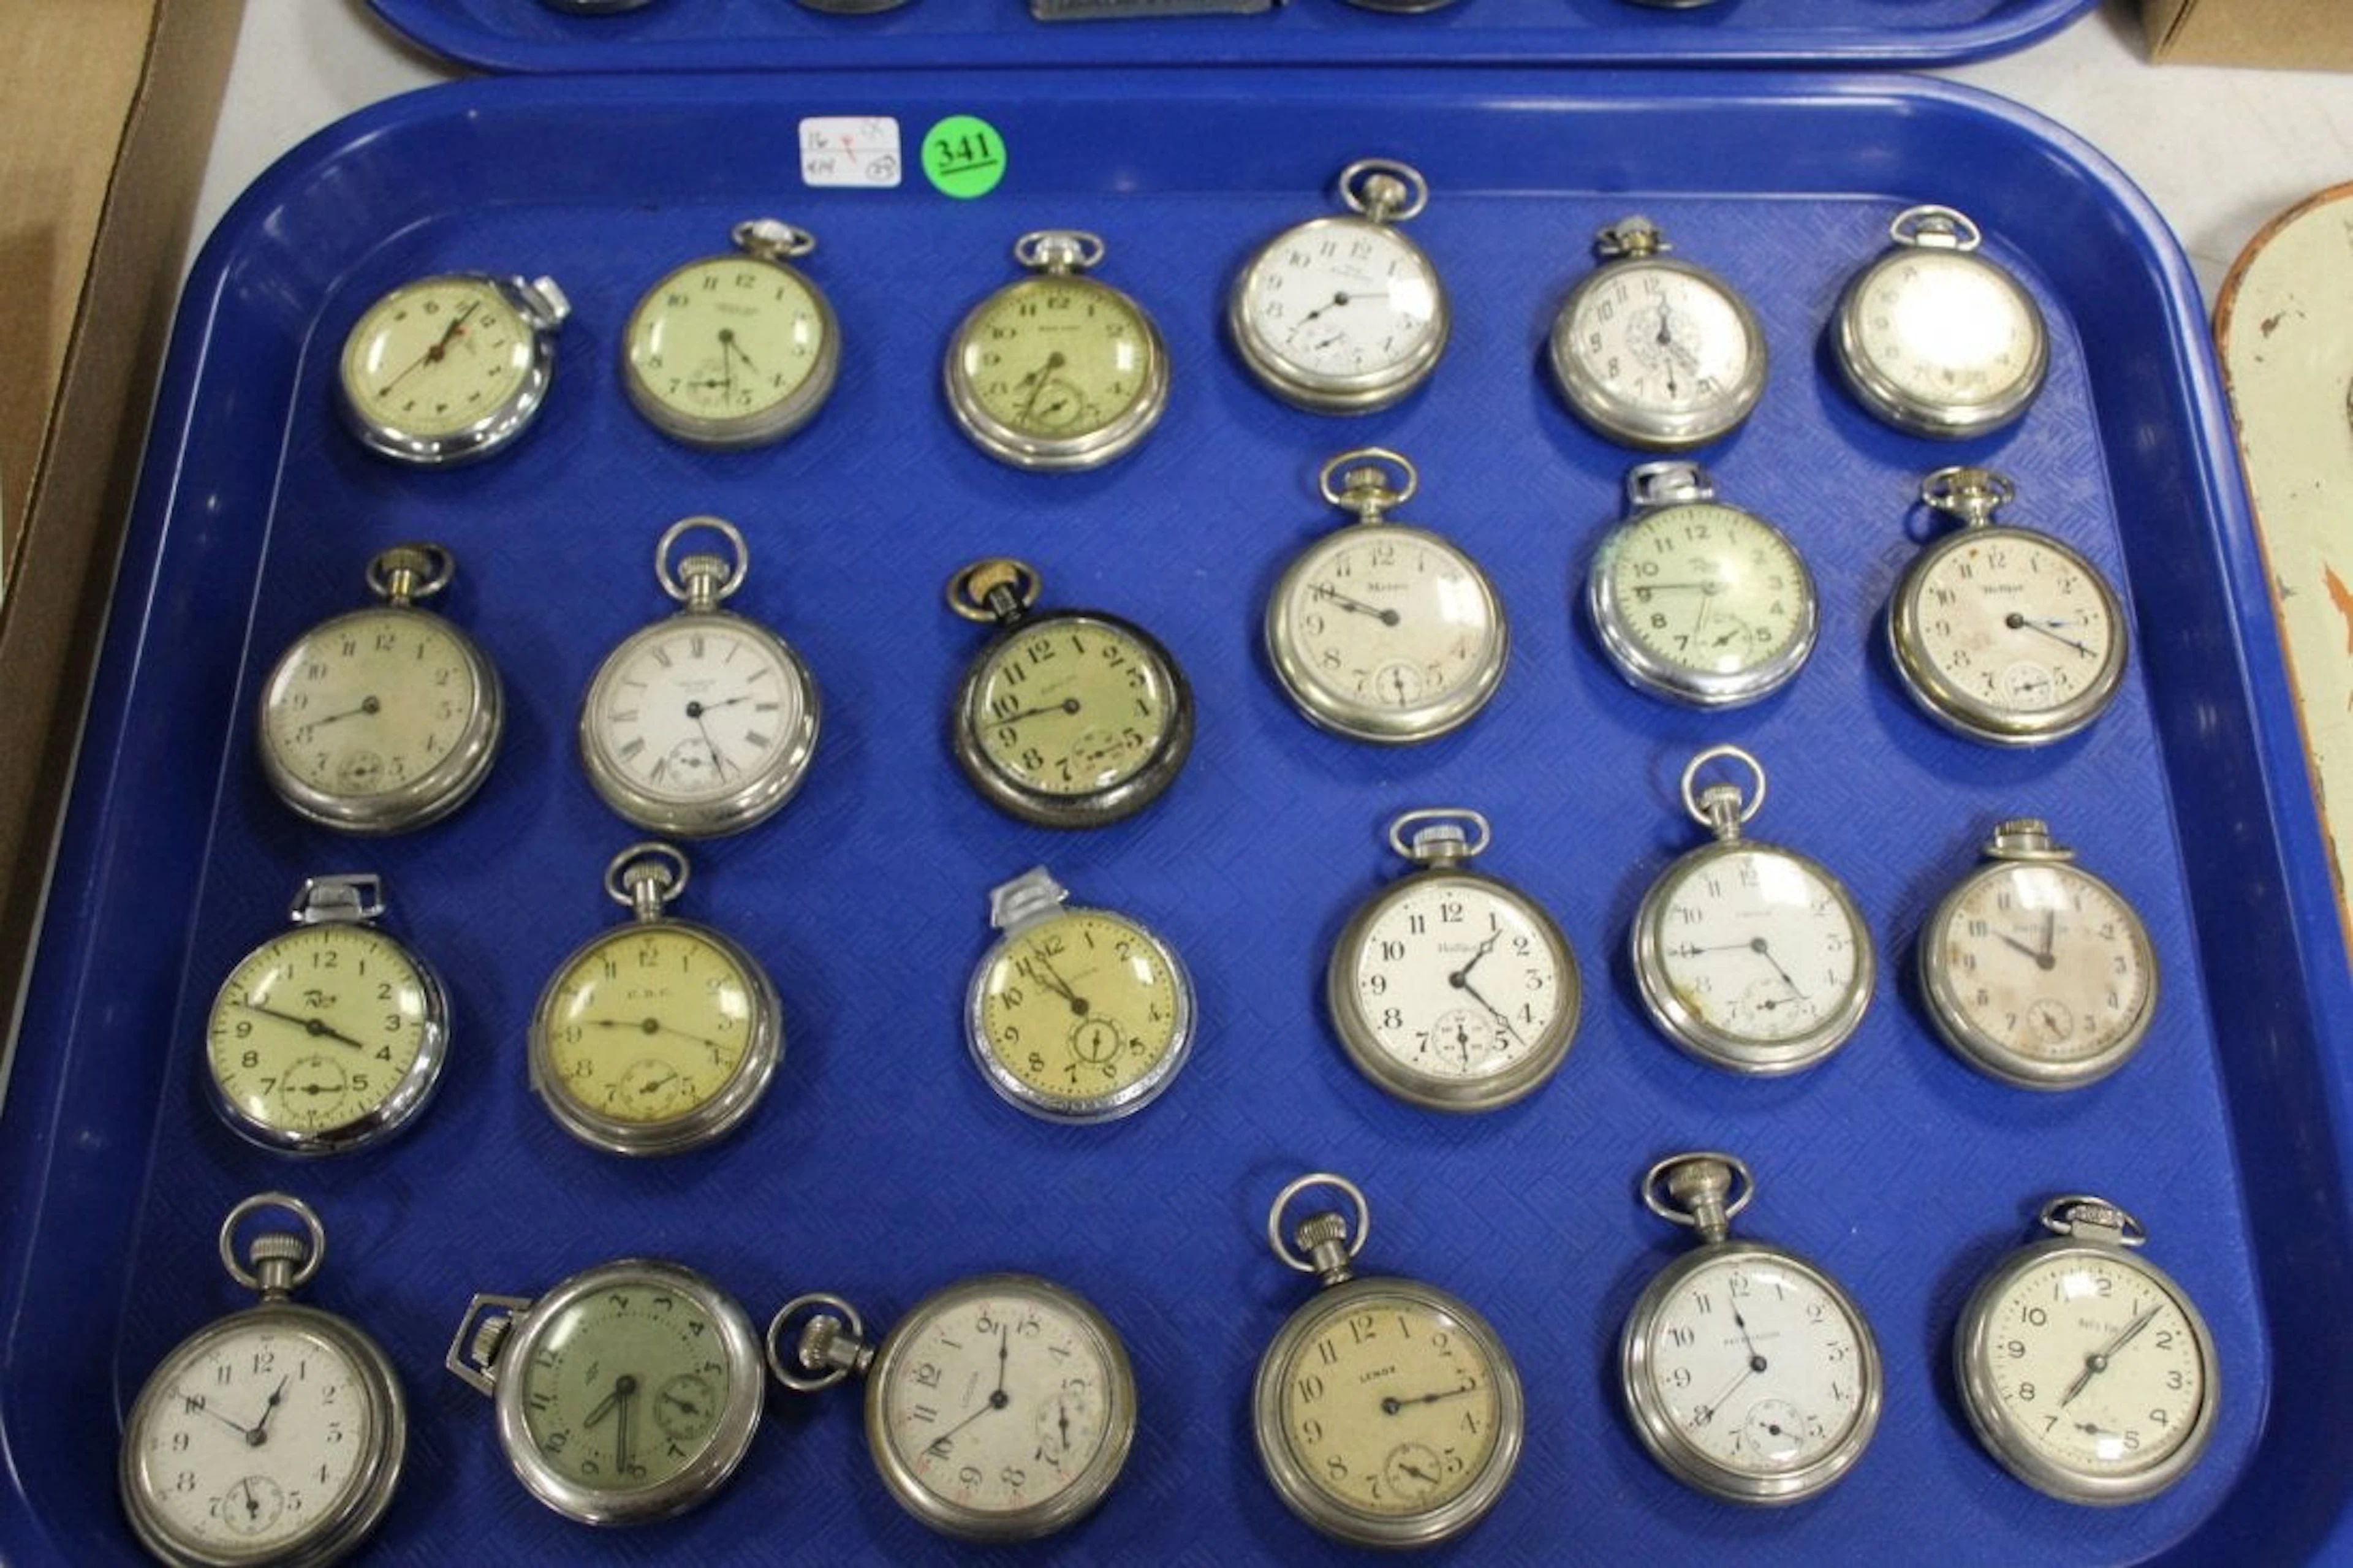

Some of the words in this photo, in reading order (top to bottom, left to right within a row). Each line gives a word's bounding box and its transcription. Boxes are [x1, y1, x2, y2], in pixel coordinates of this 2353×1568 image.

[934, 132, 989, 164] 341
[1288, 250, 1311, 268] 10
[1320, 240, 1337, 258] 11
[1350, 239, 1373, 260] 12
[703, 276, 719, 290] 11
[735, 274, 757, 289] 12
[667, 294, 689, 308] 10
[1020, 304, 1037, 317] 11
[1047, 295, 1070, 310] 12
[991, 327, 1017, 340] 10
[1684, 525, 1711, 542] 12
[1727, 529, 1737, 546] 1
[1654, 537, 1675, 554] 11
[1336, 554, 1352, 578] 11
[1372, 545, 1395, 567] 12
[1987, 552, 2007, 570] 12
[1632, 561, 1659, 578] 10
[1960, 563, 1972, 579] 11
[1634, 586, 1653, 604] 9
[1936, 589, 1957, 607] 10
[1306, 614, 1325, 636] 9
[1650, 612, 1667, 629] 8
[375, 634, 396, 651] 12
[1071, 634, 1085, 654] 1
[1673, 634, 1689, 651] 7
[1755, 626, 1773, 643] 5
[341, 640, 357, 657] 11
[417, 642, 425, 660] 1
[1025, 638, 1056, 665] 12
[1102, 645, 1126, 668] 2
[1323, 646, 1343, 670] 8
[308, 664, 327, 681] 10
[435, 668, 449, 686] 2
[1002, 662, 1027, 686] 11
[1125, 667, 1146, 688] 3
[1351, 668, 1368, 692] 7
[1981, 672, 1995, 690] 7
[990, 693, 1020, 720] 10
[998, 726, 1018, 748] 9
[1122, 726, 1143, 749] 5
[1021, 746, 1044, 771] 8
[1053, 757, 1072, 782] 7
[1740, 867, 1761, 887] 12
[1707, 879, 1722, 897] 11
[1997, 891, 2011, 911] 11
[1440, 901, 1464, 922] 12
[1680, 907, 1702, 925] 10
[1409, 914, 1426, 935] 11
[1490, 912, 1497, 932] 1
[1968, 920, 1989, 937] 10
[1044, 934, 1065, 957] 12
[1083, 931, 1095, 950] 1
[1512, 935, 1531, 956] 2
[313, 950, 338, 969] 12
[638, 949, 659, 968] 12
[1115, 941, 1131, 963] 2
[1381, 941, 1405, 961] 10
[358, 958, 366, 977] 1
[604, 961, 617, 979] 11
[681, 955, 689, 973] 1
[1014, 956, 1036, 978] 11
[1370, 974, 1387, 995] 9
[1525, 968, 1544, 991] 3
[377, 983, 392, 1000] 2
[1000, 987, 1023, 1010] 10
[385, 1015, 401, 1032] 3
[1383, 1008, 1404, 1029] 8
[1516, 1002, 1535, 1025] 4
[236, 1021, 253, 1039] 9
[566, 1026, 582, 1044] 9
[1004, 1026, 1020, 1045] 9
[1129, 1036, 1146, 1057] 5
[1414, 1031, 1430, 1053] 7
[1491, 1030, 1510, 1051] 5
[241, 1050, 259, 1069] 8
[374, 1045, 392, 1062] 4
[1028, 1051, 1045, 1073] 8
[576, 1059, 593, 1078] 8
[1063, 1063, 1077, 1084] 7
[1102, 1064, 1118, 1079] 6
[259, 1077, 276, 1096] 7
[352, 1074, 369, 1092] 5
[604, 1083, 617, 1102] 7
[681, 1077, 696, 1097] 5
[1729, 1273, 1751, 1298] 12
[1776, 1282, 1784, 1301] 1
[609, 1293, 629, 1309] 2
[653, 1297, 673, 1312] 3
[1694, 1292, 1711, 1314] 11
[2132, 1298, 2139, 1317] 1
[1806, 1303, 1824, 1324] 2
[2021, 1306, 2047, 1327] 10
[688, 1321, 705, 1336] 4
[975, 1317, 999, 1336] 2
[1015, 1320, 1040, 1337] 3
[1349, 1316, 1377, 1344] 12
[1398, 1315, 1411, 1339] 1
[941, 1338, 963, 1350] 1
[1432, 1332, 1453, 1357] 2
[1669, 1326, 1696, 1348] 10
[2155, 1329, 2173, 1350] 2
[1317, 1338, 1338, 1365] 11
[1826, 1340, 1844, 1362] 3
[2007, 1339, 2026, 1359] 9
[253, 1352, 275, 1375] 12
[299, 1360, 306, 1381] 1
[704, 1361, 722, 1375] 5
[218, 1365, 232, 1385] 11
[915, 1362, 942, 1390] 12
[1455, 1368, 1477, 1392] 3
[1673, 1366, 1691, 1387] 9
[2165, 1370, 2183, 1390] 3
[322, 1385, 336, 1404] 2
[1297, 1376, 1324, 1404] 10
[2018, 1381, 2036, 1401] 8
[530, 1392, 551, 1412] 11
[912, 1404, 938, 1424] 11
[1460, 1410, 1478, 1435] 4
[1693, 1404, 1715, 1427] 8
[2045, 1415, 2058, 1433] 7
[2148, 1409, 2170, 1428] 4
[326, 1422, 343, 1443] 3
[1302, 1418, 1323, 1444] 9
[1807, 1414, 1824, 1437] 5
[172, 1433, 189, 1452] 9
[544, 1432, 567, 1453] 10
[927, 1436, 953, 1460] 10
[1728, 1428, 1742, 1451] 7
[2123, 1430, 2140, 1450] 5
[667, 1443, 687, 1457] 7
[1034, 1446, 1061, 1472] 7
[1443, 1447, 1464, 1473] 5
[581, 1460, 600, 1475] 9
[958, 1466, 982, 1489] 9
[1000, 1465, 1026, 1488] 8
[1327, 1454, 1348, 1481] 8
[176, 1472, 195, 1492] 8
[1365, 1474, 1382, 1499] 7
[209, 1497, 222, 1518] 7
[287, 1490, 302, 1510] 5
